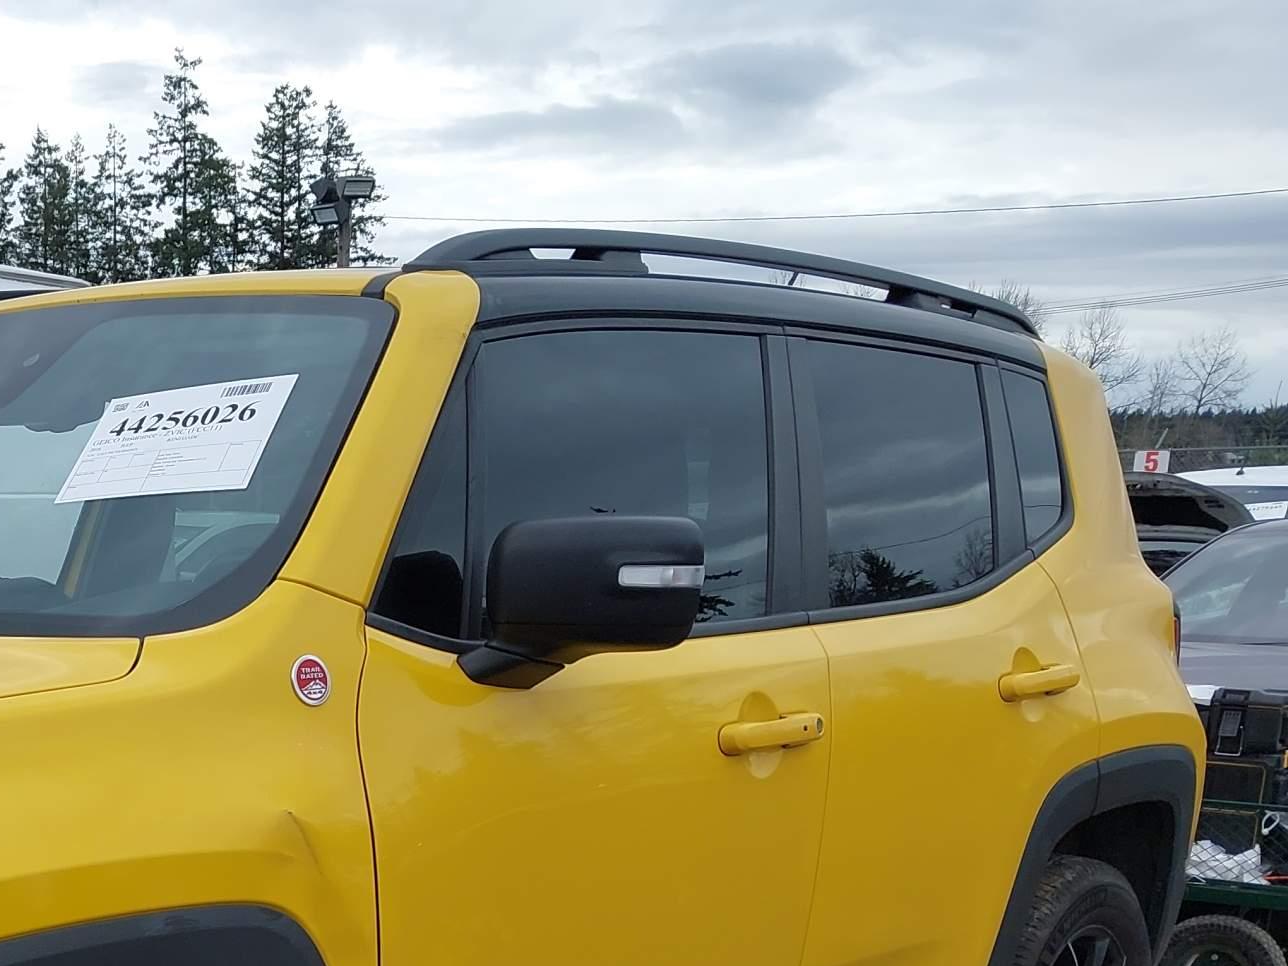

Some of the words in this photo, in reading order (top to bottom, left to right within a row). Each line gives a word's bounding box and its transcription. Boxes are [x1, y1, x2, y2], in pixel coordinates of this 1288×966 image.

[109, 400, 262, 436] 44256026
[93, 437, 121, 447] GEICO
[1144, 452, 1159, 472] 5
